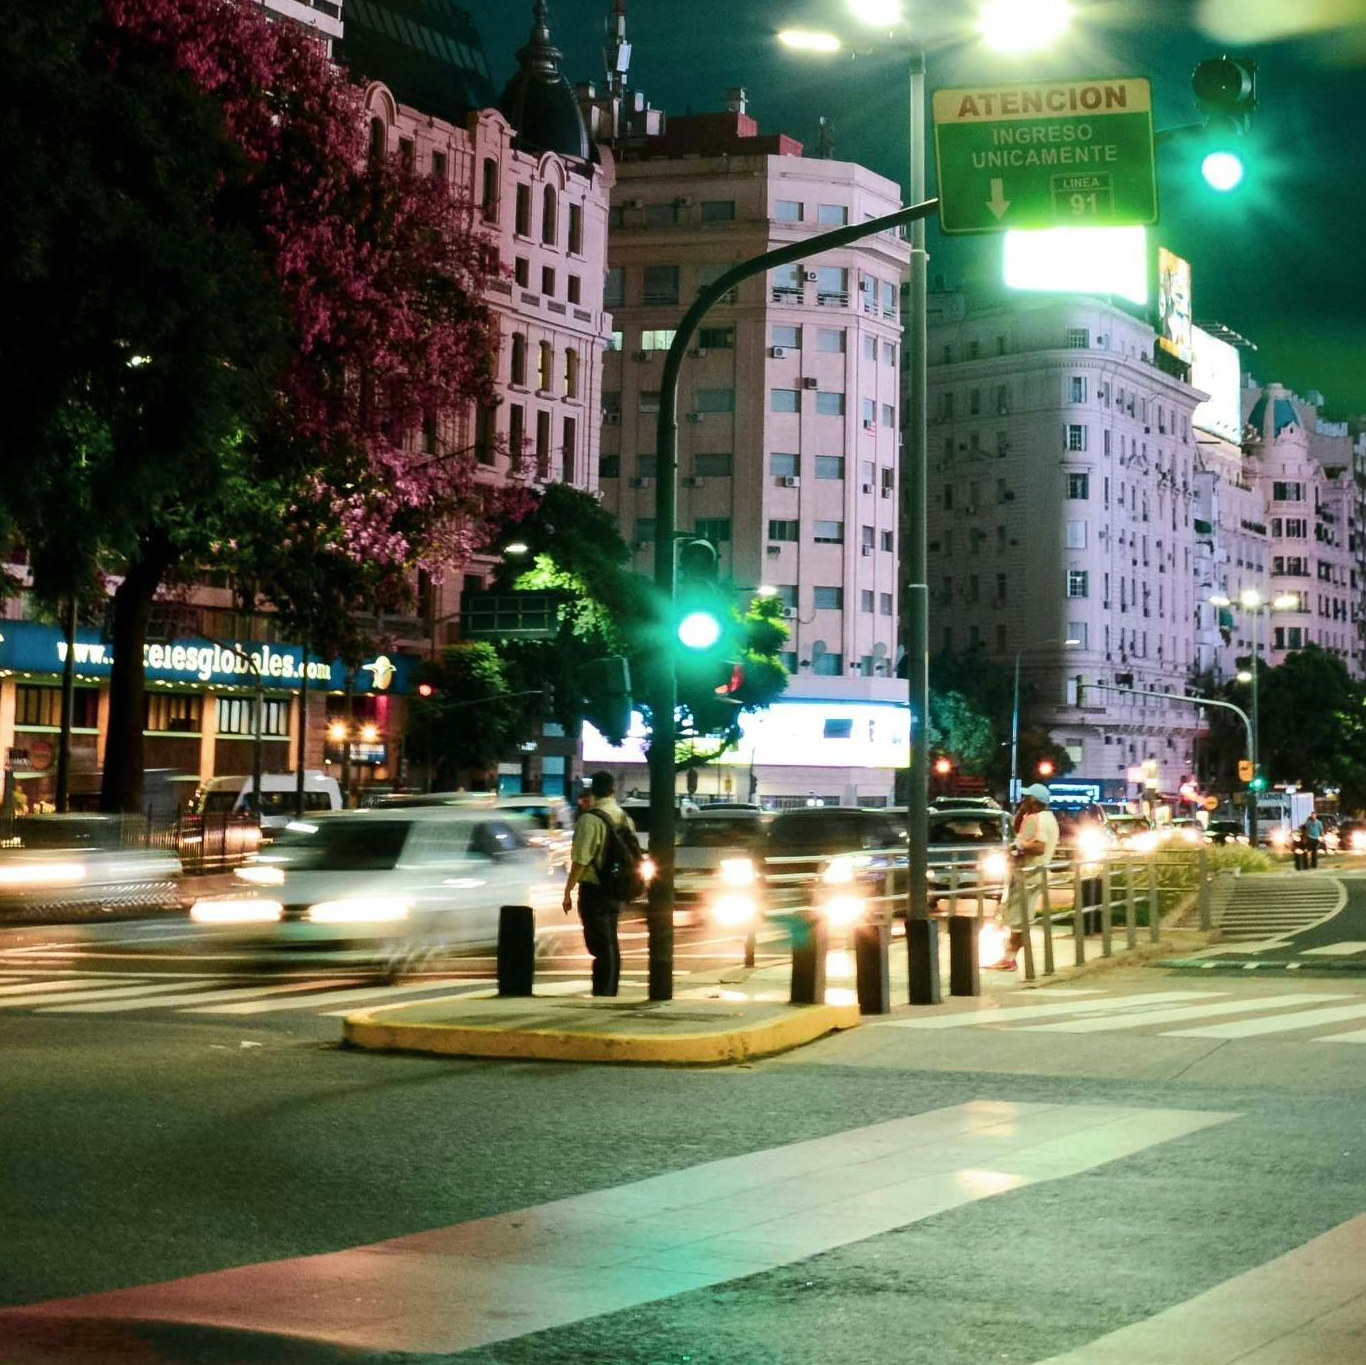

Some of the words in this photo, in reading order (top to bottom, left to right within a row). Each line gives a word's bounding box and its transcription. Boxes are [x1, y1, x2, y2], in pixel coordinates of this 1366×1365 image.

[958, 85, 1127, 117] ATENCION
[992, 123, 1093, 146] INGRESO
[971, 145, 1119, 169] UNICAMENTE
[1069, 192, 1098, 216] 91
